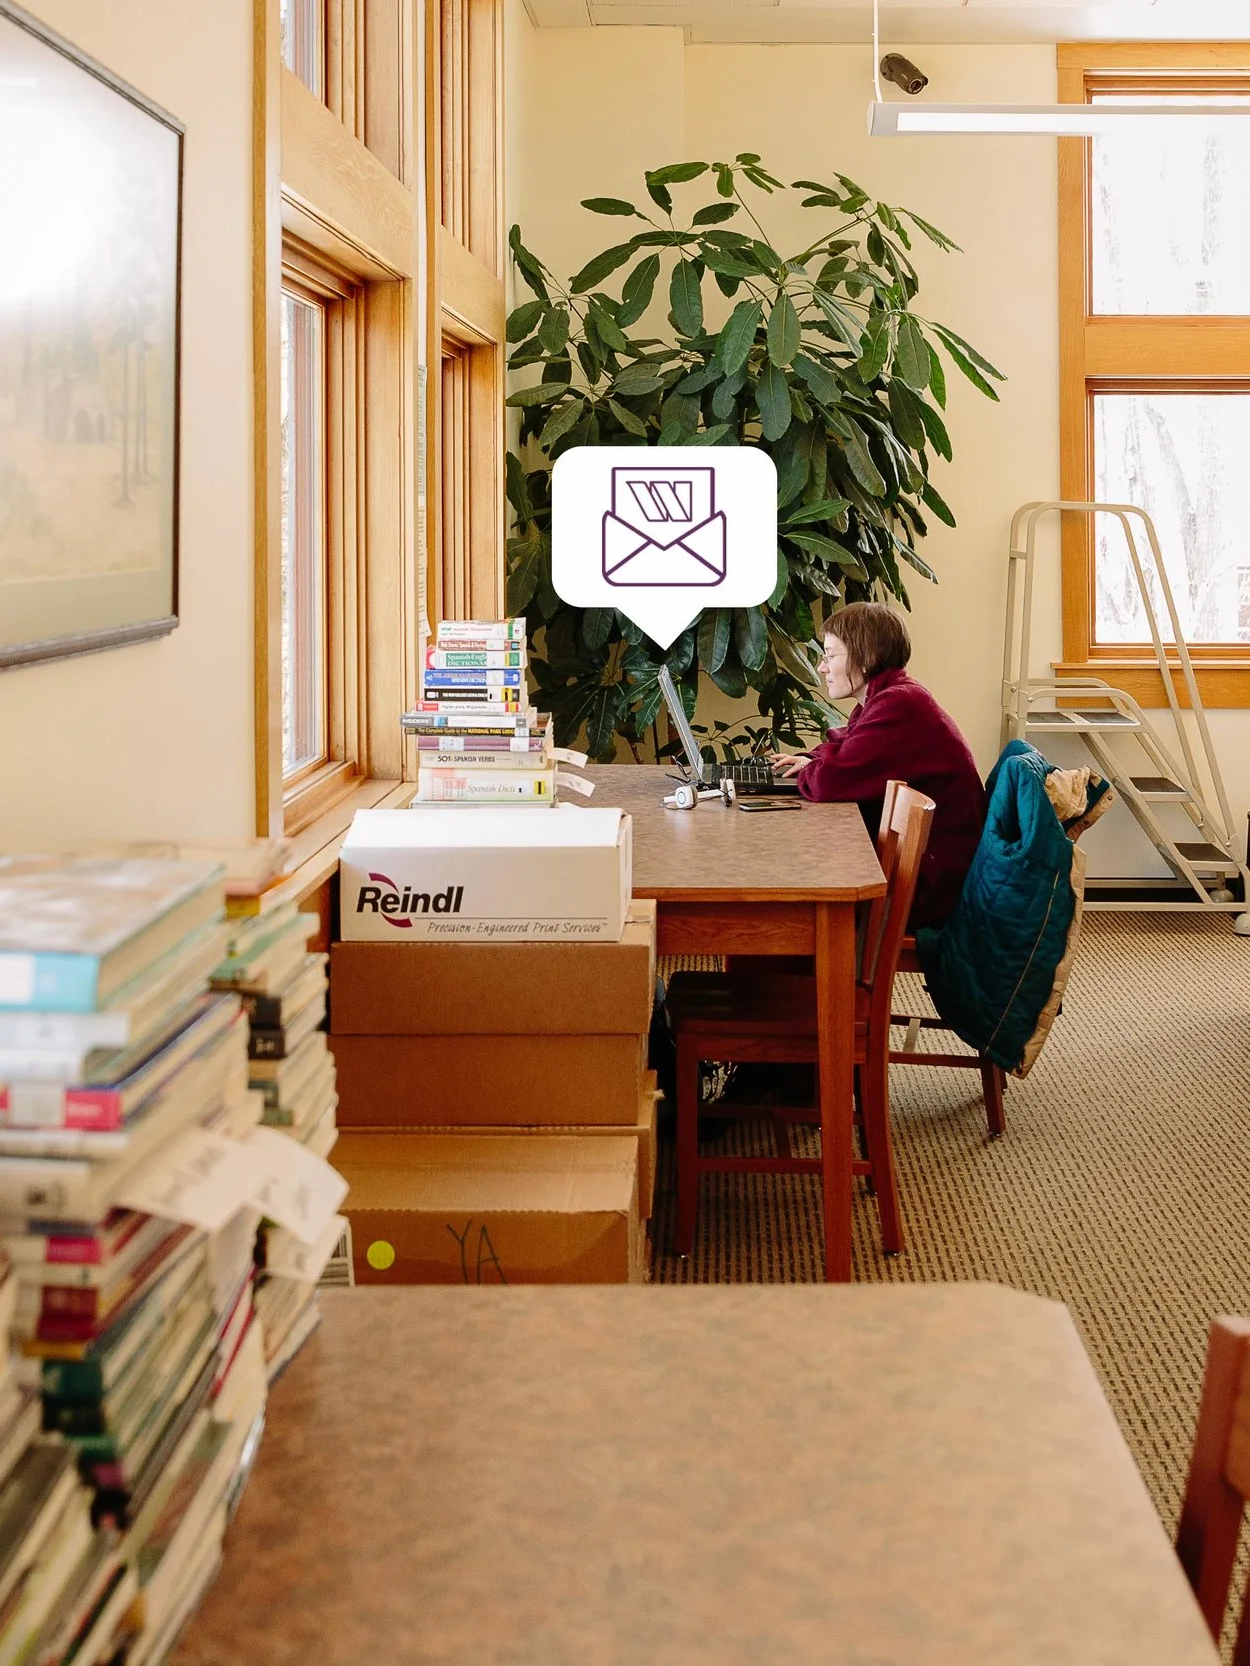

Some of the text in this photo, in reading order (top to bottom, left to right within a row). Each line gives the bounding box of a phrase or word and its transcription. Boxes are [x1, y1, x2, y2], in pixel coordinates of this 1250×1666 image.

[467, 785, 496, 793] Spanish
[356, 886, 464, 913] Reindl
[427, 921, 529, 936] Precision-Engineered
[533, 922, 559, 933] Print
[447, 1218, 508, 1285] YA
